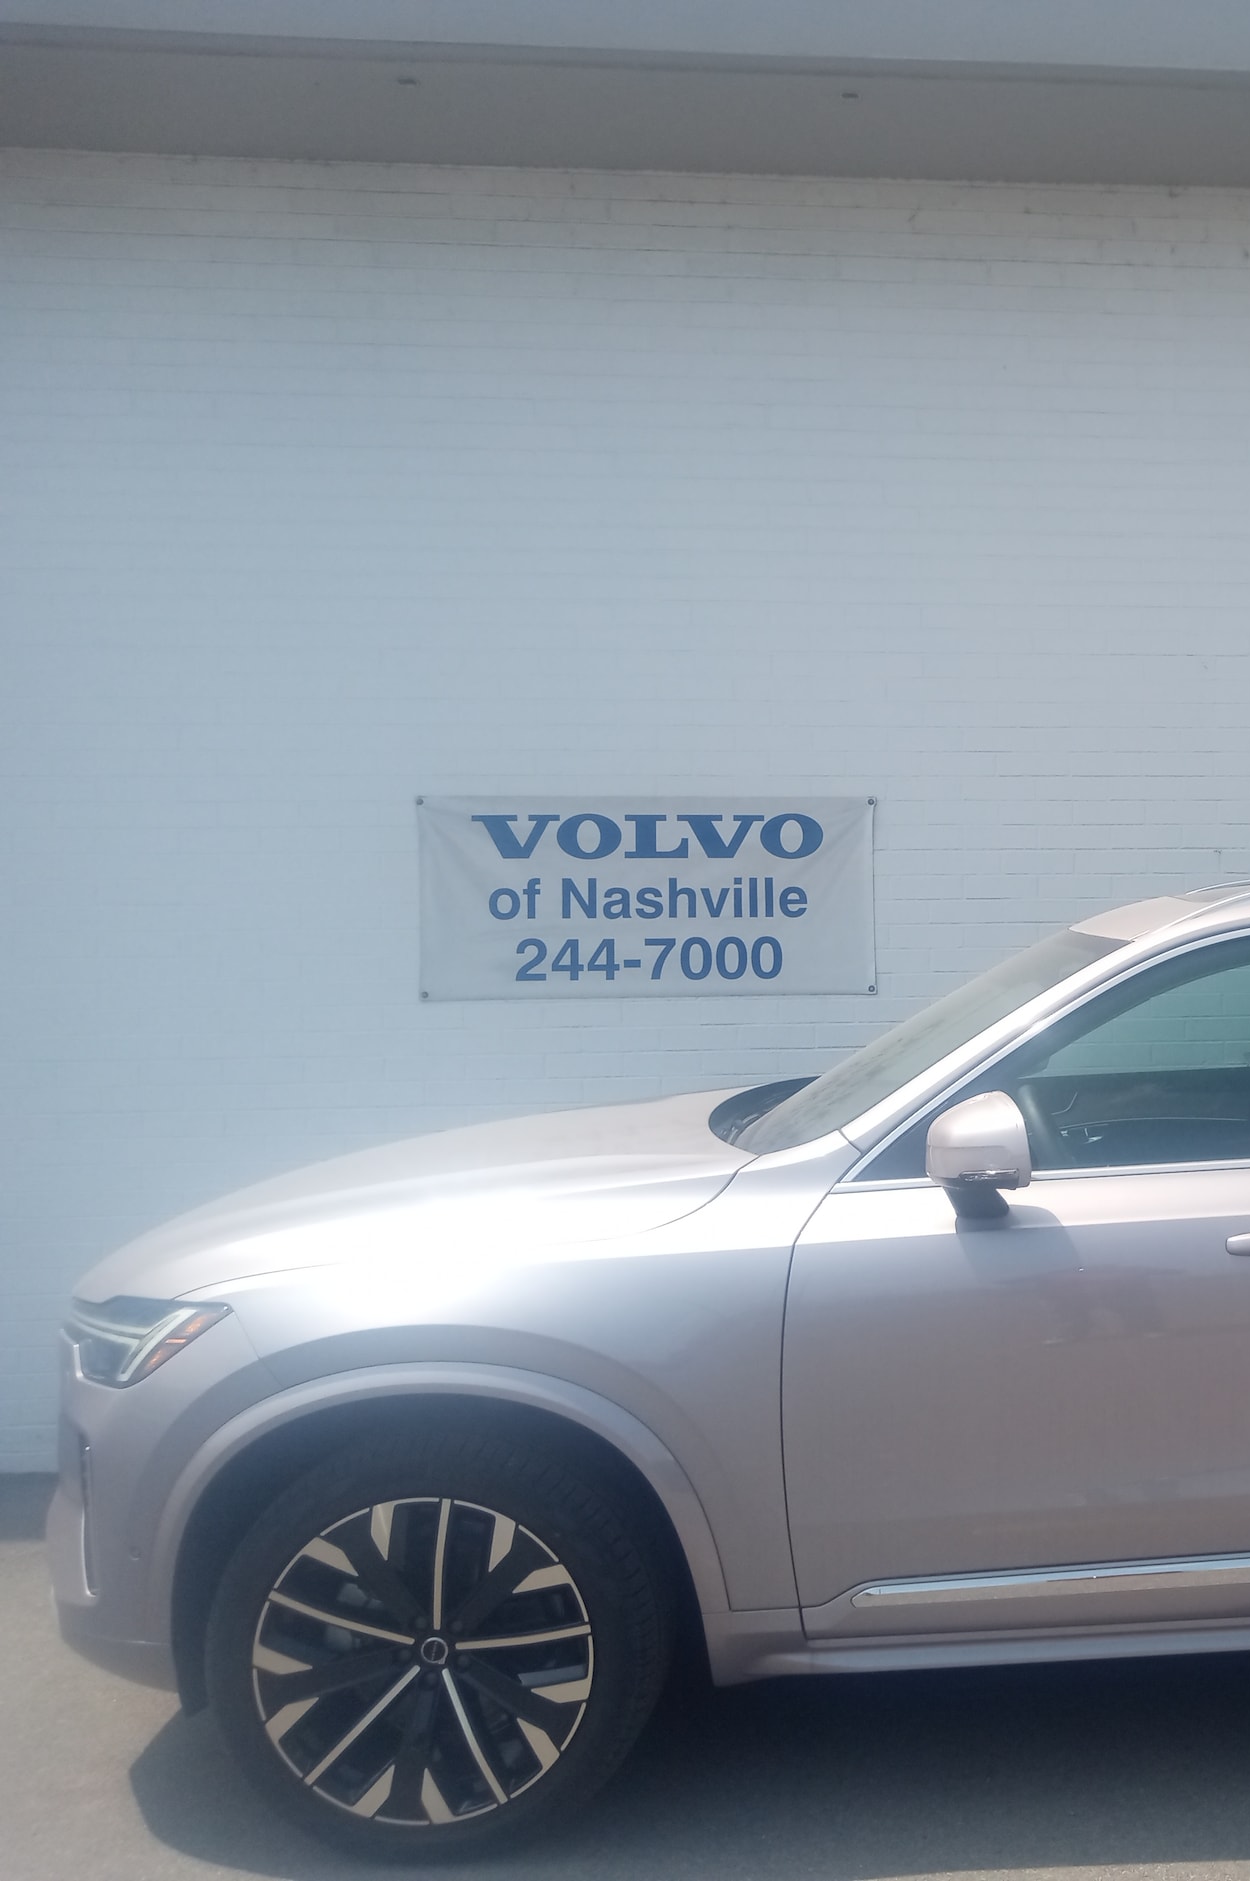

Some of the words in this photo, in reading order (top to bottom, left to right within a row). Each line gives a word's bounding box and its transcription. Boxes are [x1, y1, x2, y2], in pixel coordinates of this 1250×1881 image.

[471, 813, 823, 859] VOLVO
[488, 877, 541, 920] of
[561, 877, 808, 920] Nashville
[515, 936, 783, 982] 244-7000
